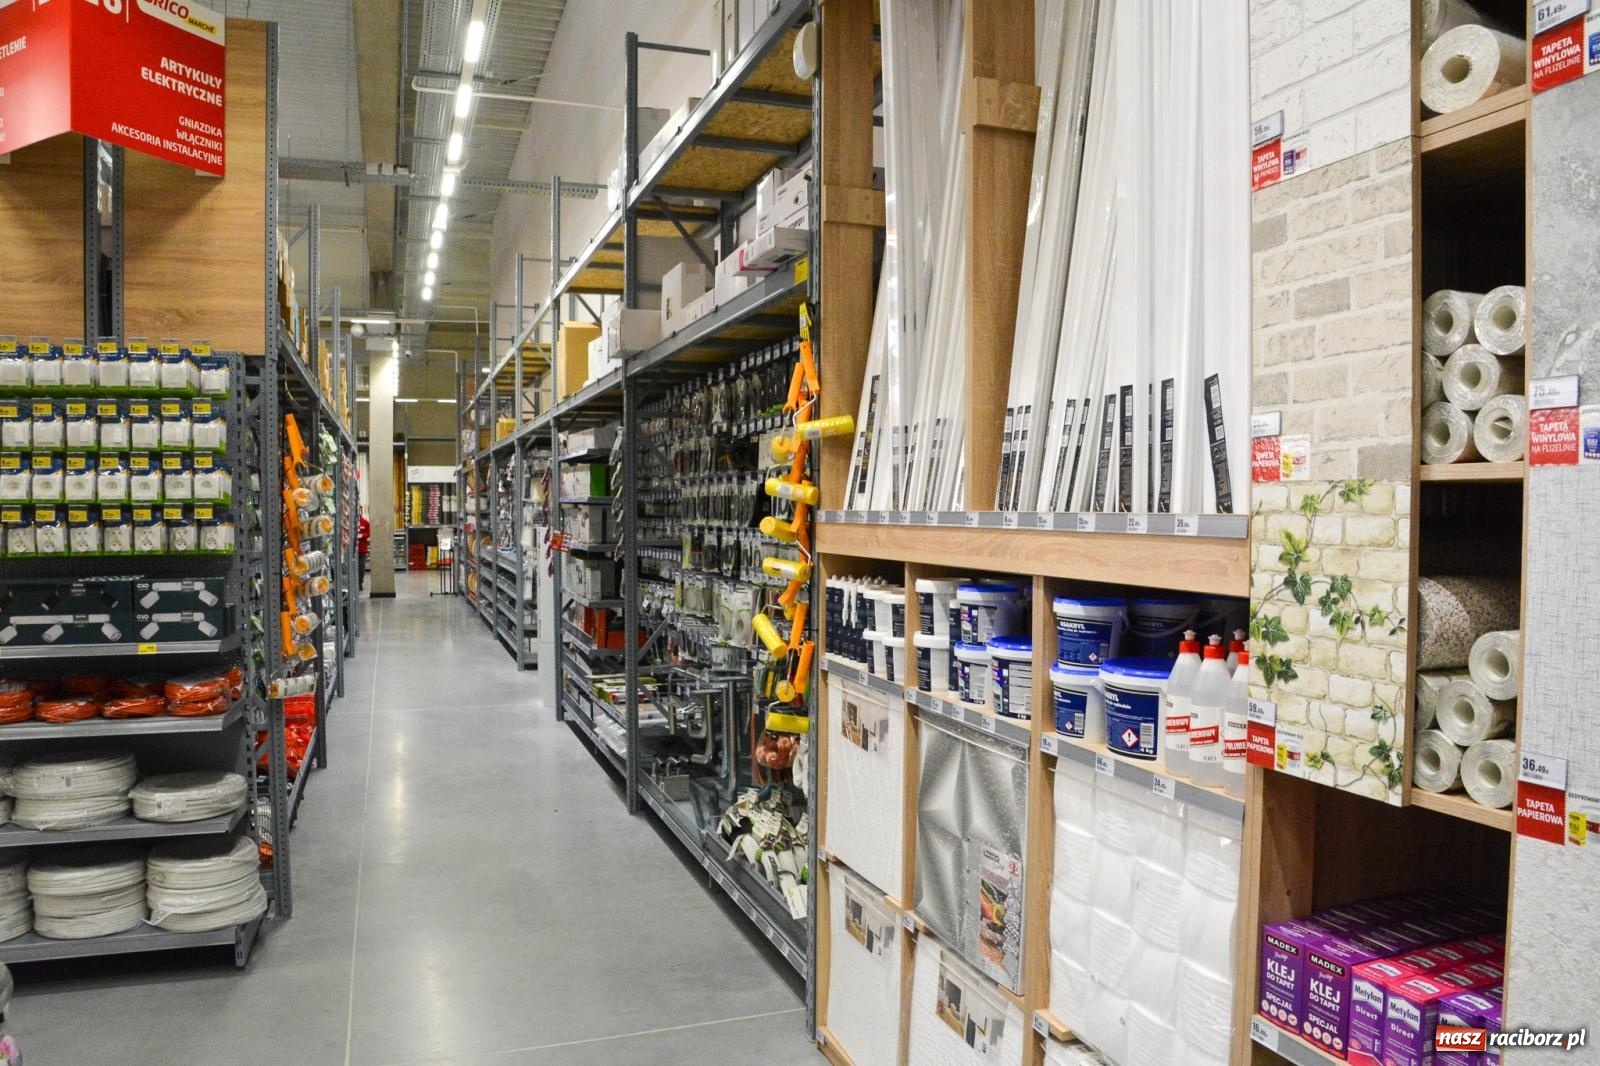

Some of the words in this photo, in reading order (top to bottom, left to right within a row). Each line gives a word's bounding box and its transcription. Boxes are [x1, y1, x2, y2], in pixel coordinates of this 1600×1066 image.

[1541, 36, 1573, 56] TAPETA
[1533, 43, 1581, 70] WINYLOWA
[160, 57, 222, 89] ARTYKUŁY
[1533, 71, 1544, 80] NA
[1544, 55, 1581, 74] FLIZELINIE
[141, 66, 222, 107] ELEKTRYCZNE
[179, 116, 222, 138] GNIAZDKA
[111, 121, 161, 147] AKCESORIA
[163, 139, 222, 165] INSTALACYJNE
[176, 129, 222, 151] WŁĄCZNIKI
[1539, 422, 1569, 432] TAPETA
[1531, 432, 1576, 443] WINYLOWA
[1525, 798, 1555, 813] TAPETA
[1517, 807, 1563, 826] PAPIEROWA
[1267, 936, 1297, 954] MADEX
[1267, 958, 1295, 981] KLEJ
[1310, 955, 1343, 975] MADEX
[1266, 971, 1275, 980] DO
[1275, 976, 1295, 989] TAPET
[1310, 978, 1340, 1003] KLEJ
[1354, 984, 1382, 1005] Metylan
[1266, 991, 1293, 1011] SPECJAL
[1309, 993, 1319, 1003] DO
[1319, 996, 1340, 1012] TAPET
[1355, 1004, 1378, 1021] Direct
[1389, 1001, 1419, 1023] Metylan
[1308, 1013, 1338, 1034] SPECJAL
[1391, 1022, 1415, 1040] Direct
